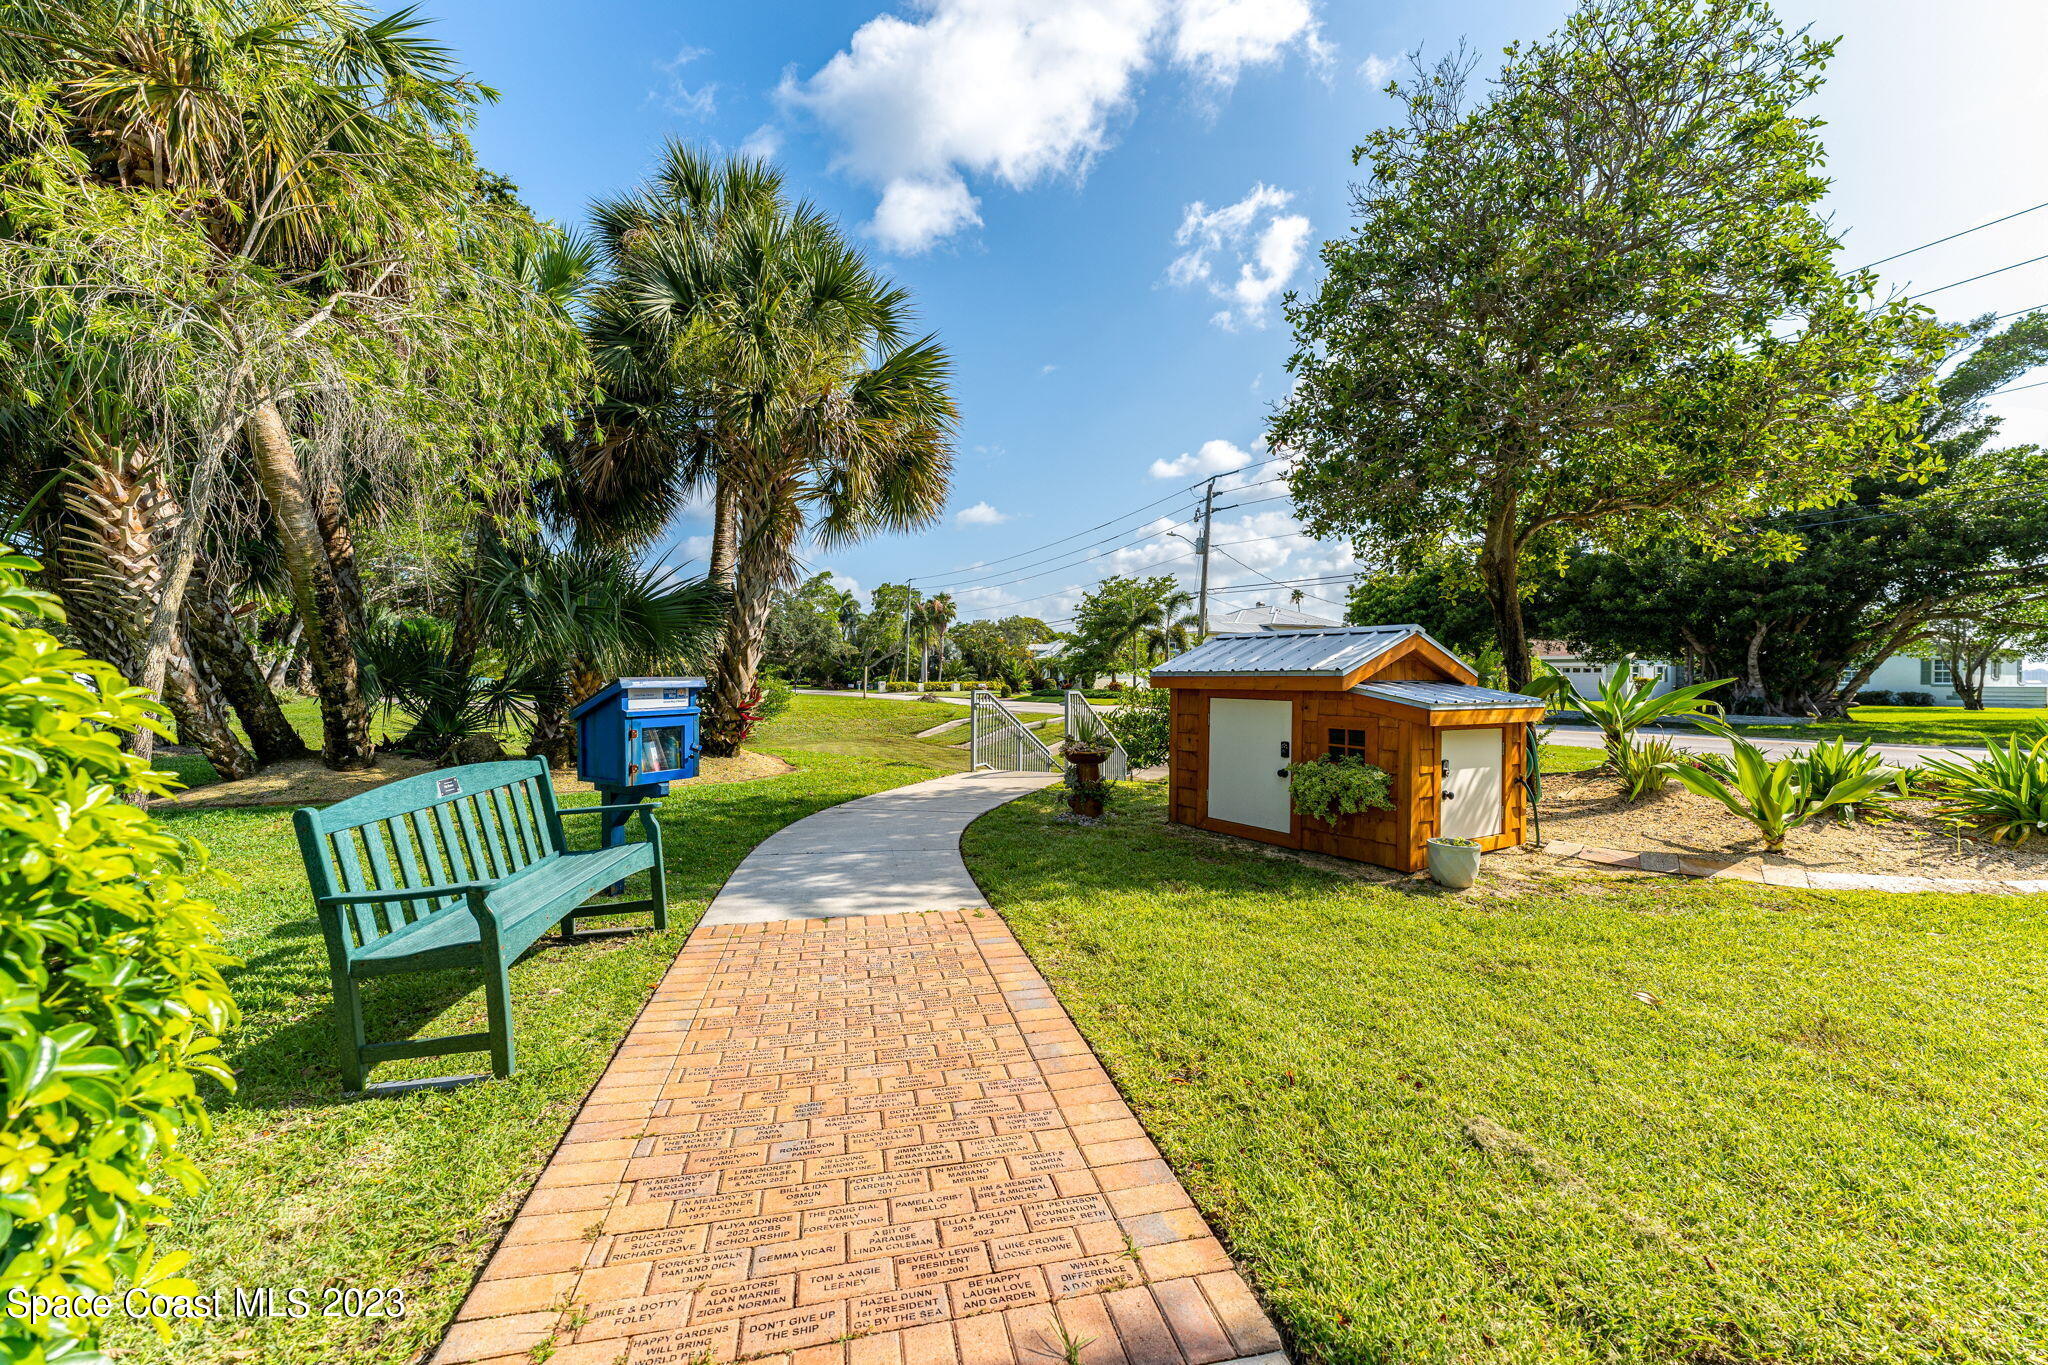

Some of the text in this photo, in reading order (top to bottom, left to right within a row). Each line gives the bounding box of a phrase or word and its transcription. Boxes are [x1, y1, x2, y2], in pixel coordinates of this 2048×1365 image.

[648, 1181, 704, 1192] MARGARET
[853, 1181, 893, 1191] GARDEN
[1005, 1177, 1043, 1188] MEMORY
[650, 1188, 698, 1198] KENNEDY
[786, 1191, 821, 1199] OSMUN
[993, 1192, 1038, 1204] CROWLEY
[896, 1193, 963, 1208] PAMELA CRIST
[1049, 1196, 1098, 1208] PETERSON
[829, 1206, 856, 1215] DOUG
[858, 1203, 878, 1211] DIAL
[914, 1203, 947, 1213] MELLO
[1035, 1204, 1097, 1218] FOUNDATION
[716, 1215, 793, 1230] ALIYA MONROE
[828, 1213, 860, 1222] FAMILY
[942, 1217, 968, 1226] ELLA
[979, 1209, 1016, 1221] KELLAN
[803, 1217, 884, 1233] FOREVER YOUNG
[952, 1224, 974, 1232] 2015
[623, 1230, 685, 1243] EDUCATION
[715, 1231, 790, 1247] SCHOLARSHIP
[726, 1229, 750, 1237] 2022
[869, 1233, 917, 1244] PARADISE
[631, 1237, 683, 1250] SUCCESS
[854, 1239, 932, 1254] LINDA COLEMAN
[998, 1235, 1066, 1250] LUKE CROWE
[1035, 1243, 1072, 1254] CROWE
[612, 1244, 697, 1261] RICHARD DOVE
[713, 1252, 743, 1261] WALK
[759, 1252, 799, 1263] GEMMA
[898, 1245, 980, 1265] BEVERLY LEWIS
[661, 1262, 736, 1278] PAM AND DICK
[911, 1257, 970, 1271] PRESIDENT
[1070, 1259, 1098, 1270] WHAT
[682, 1274, 712, 1283] DUNN
[810, 1275, 833, 1283] TOM
[848, 1267, 881, 1277] ANGIE
[914, 1271, 937, 1280] 1999
[947, 1266, 969, 1275] 2001
[1061, 1265, 1127, 1282] DIFFERENCE
[824, 1279, 867, 1291] LEENEY
[968, 1273, 1021, 1288] BE HAPPY
[711, 1280, 777, 1296] GO GATORS!
[962, 1281, 1032, 1299] LAUGH LOVE
[705, 1288, 781, 1306] ALAN MARNIE
[738, 1297, 786, 1310] NORMAN
[860, 1290, 932, 1307] HAZEL DUNN
[963, 1291, 1036, 1310] AND GARDEN
[594, 1309, 624, 1319] MIKE
[641, 1299, 681, 1311] DOTTY
[856, 1298, 938, 1318] 1st PRESIDENT
[614, 1313, 655, 1326] FOLEY
[750, 1311, 835, 1333] DON'T GIVE UP
[854, 1309, 943, 1330] GC BY THE SEA
[633, 1325, 729, 1348] HAPPY GARDENS
[765, 1325, 819, 1341] THE SHIP
[647, 1339, 712, 1355] WILL BRING
[634, 1354, 676, 1365] WORLD
